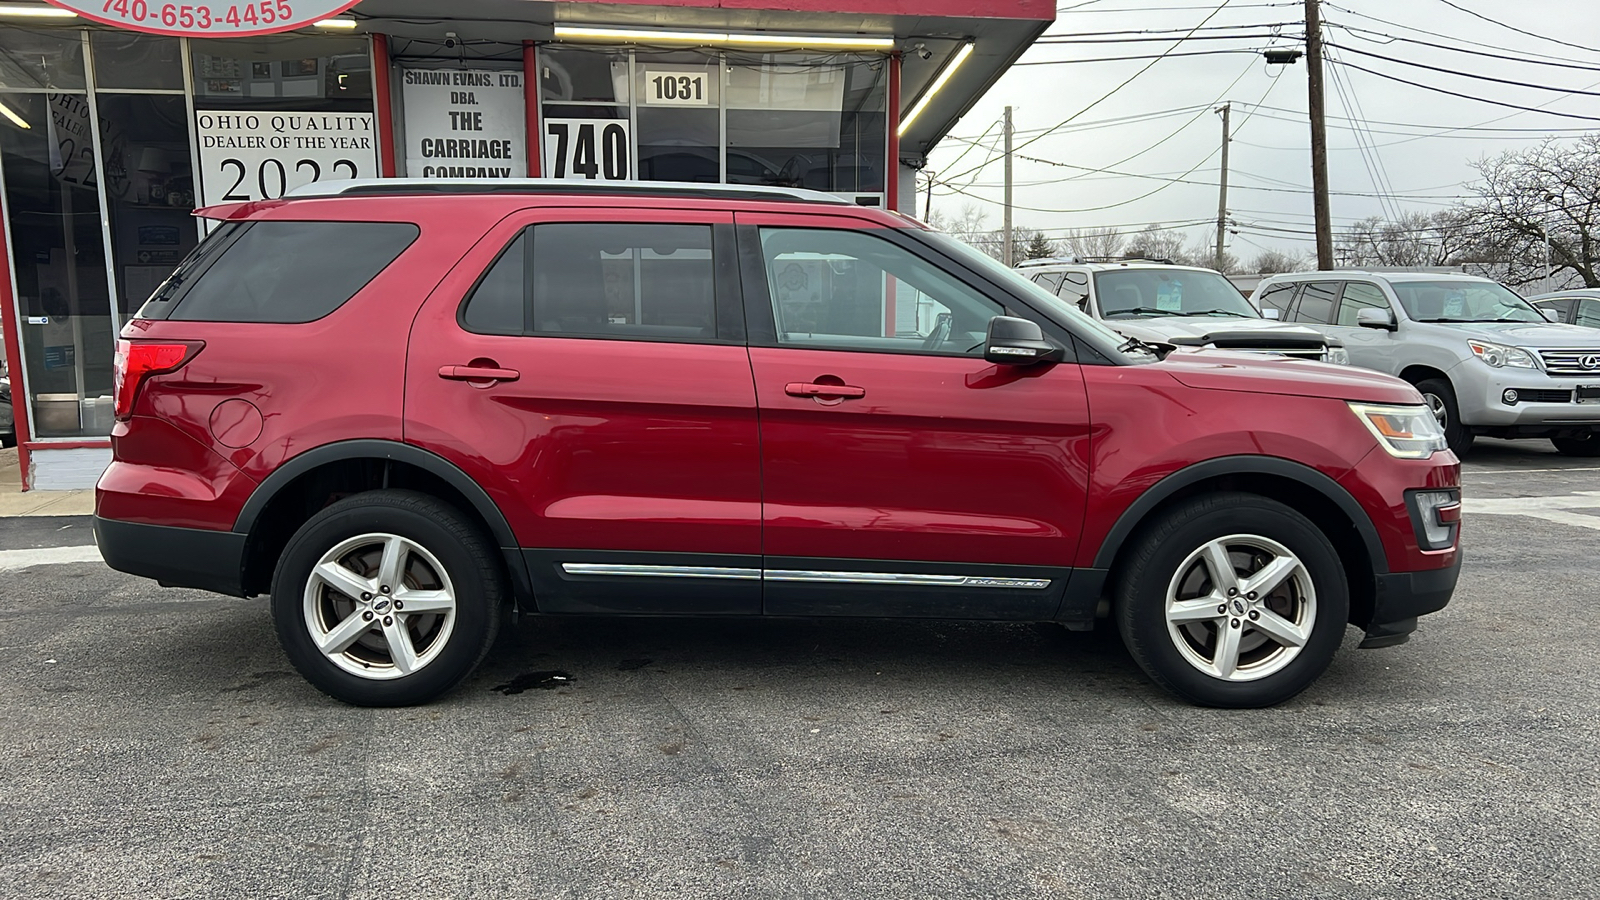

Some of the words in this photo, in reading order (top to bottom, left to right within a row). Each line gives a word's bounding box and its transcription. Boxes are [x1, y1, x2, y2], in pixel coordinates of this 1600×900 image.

[405, 71, 450, 86] SHAWN
[453, 72, 494, 87] EVANS.
[499, 74, 522, 88] LTD.
[652, 76, 702, 100] 1031
[450, 91, 479, 105] DBA.
[199, 115, 260, 130] OHIO
[271, 116, 372, 133] QUALITY
[448, 111, 483, 131] THE
[203, 135, 267, 149] DEALER
[270, 136, 291, 149] OF
[294, 137, 326, 149] THE
[329, 137, 371, 149] YEAR
[421, 138, 512, 159] CARRIAGE
[548, 123, 628, 180] 740
